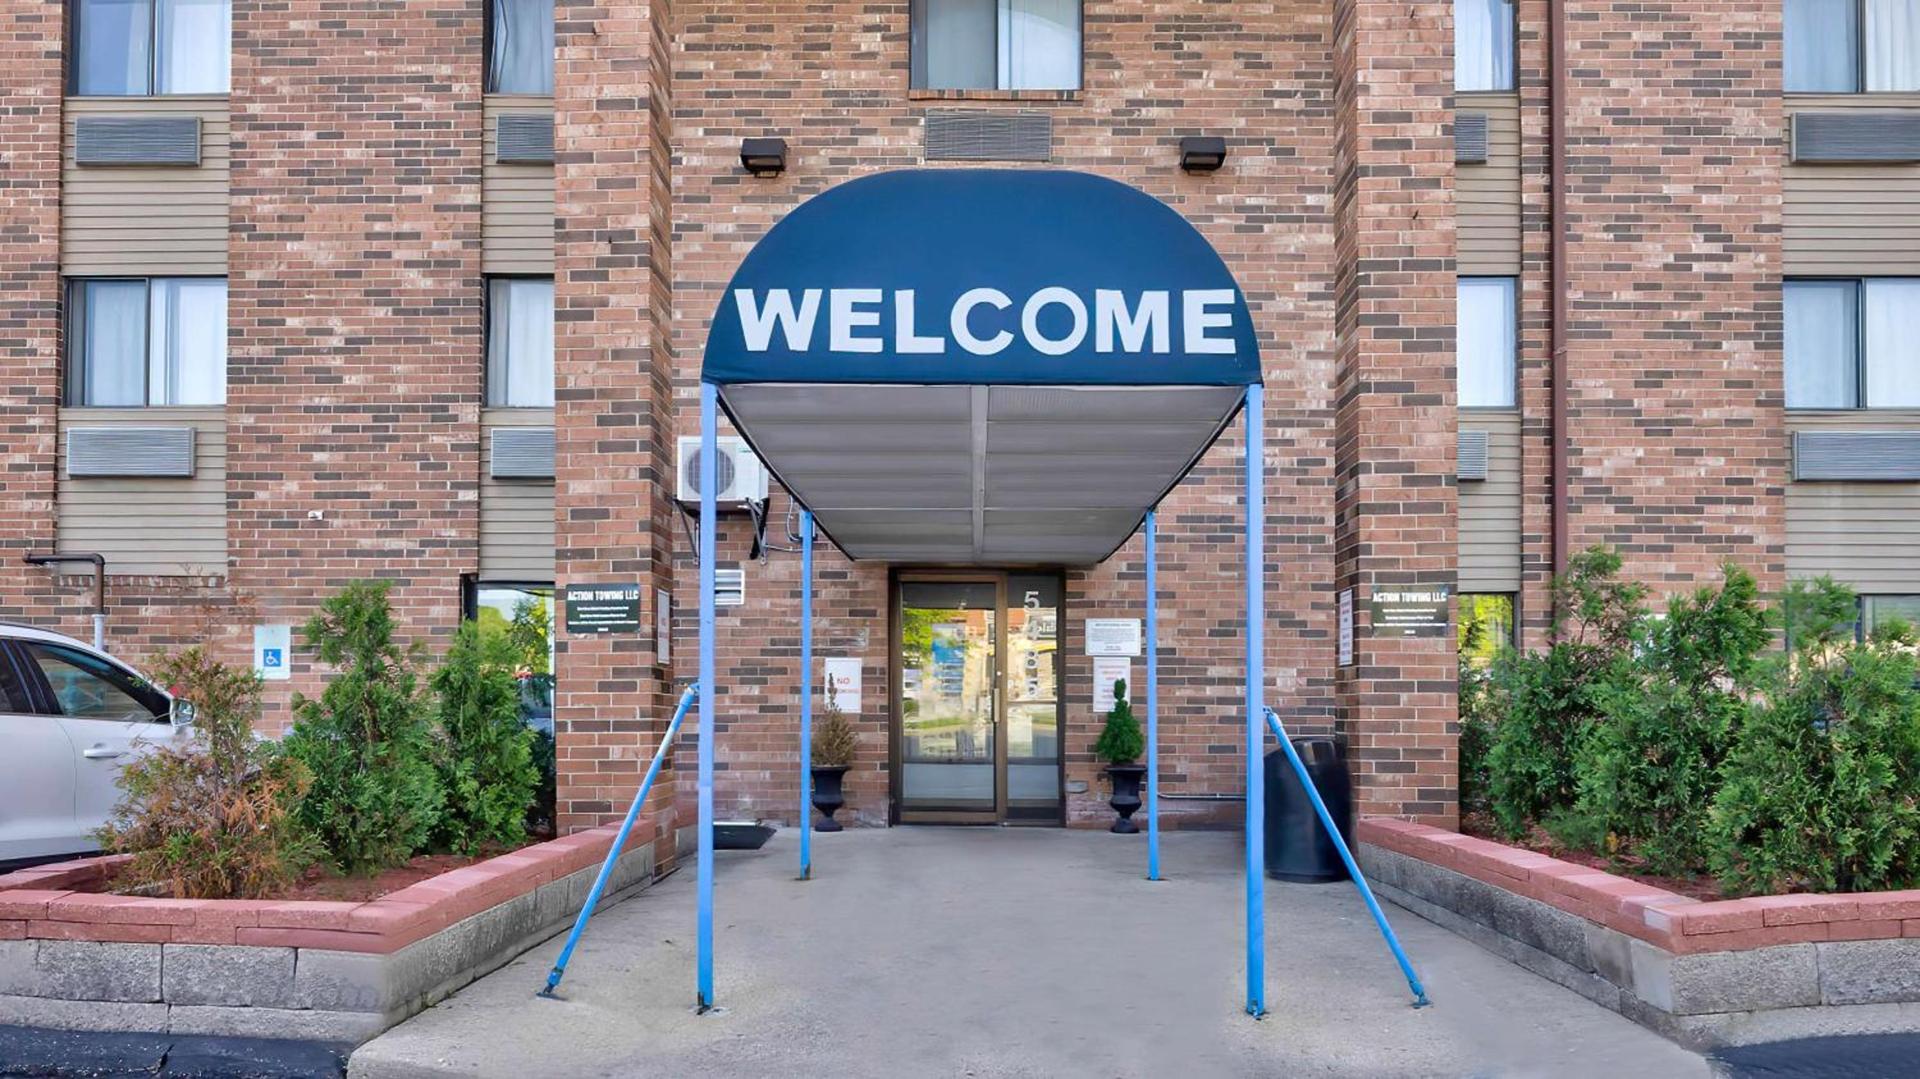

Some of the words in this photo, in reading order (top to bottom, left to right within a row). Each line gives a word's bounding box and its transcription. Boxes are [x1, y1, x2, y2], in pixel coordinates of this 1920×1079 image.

[734, 286, 1236, 356] WELCOME
[568, 590, 594, 601] ACTION
[595, 590, 624, 600] TOWING
[625, 590, 639, 600] LLC
[1372, 592, 1400, 602] ACTION
[1401, 592, 1431, 602] TOWING
[1432, 592, 1447, 602] LLC
